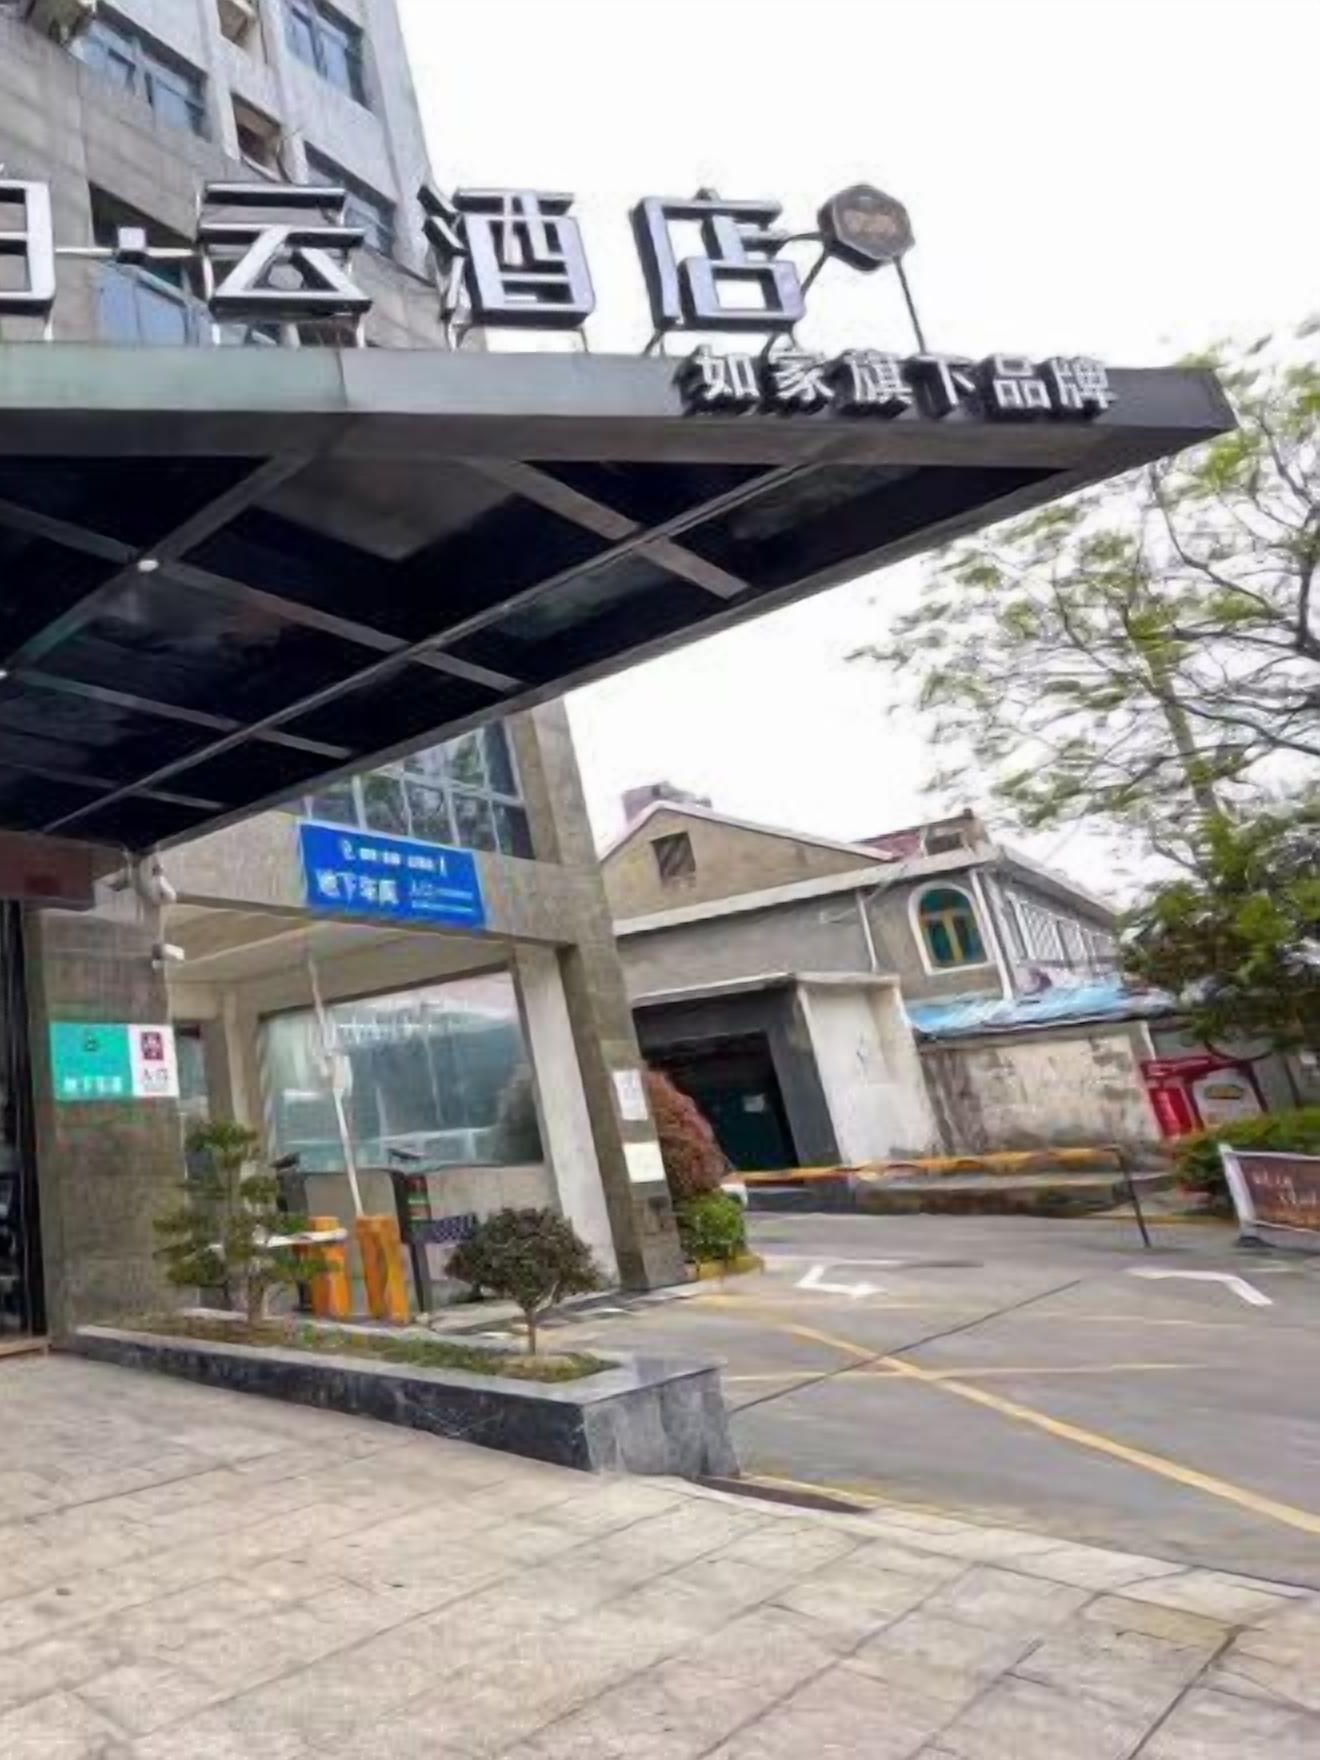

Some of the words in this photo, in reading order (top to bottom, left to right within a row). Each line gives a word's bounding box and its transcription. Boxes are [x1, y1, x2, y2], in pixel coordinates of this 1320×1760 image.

[684, 347, 1114, 411] 如家旗下品牌
